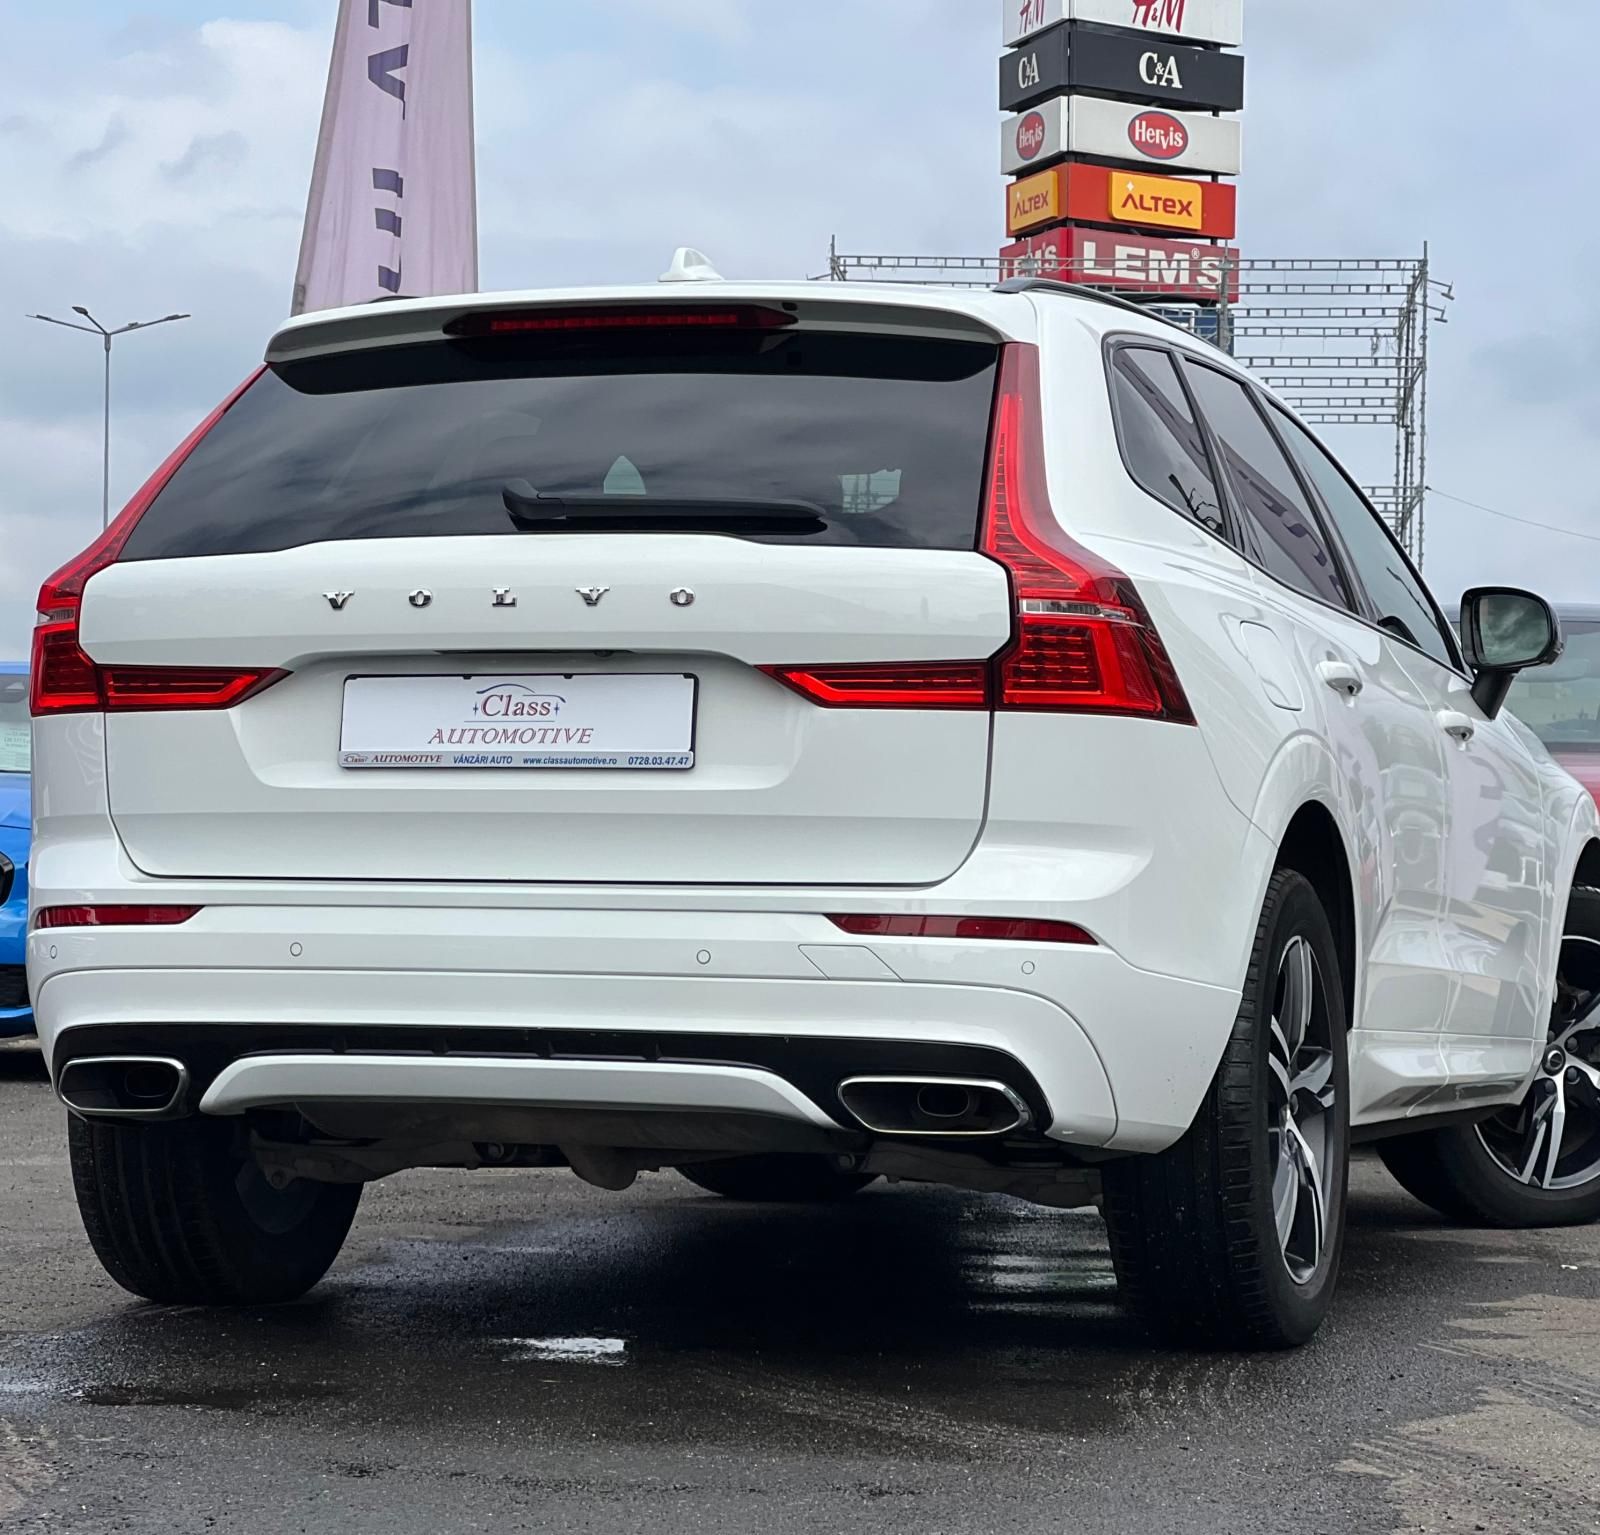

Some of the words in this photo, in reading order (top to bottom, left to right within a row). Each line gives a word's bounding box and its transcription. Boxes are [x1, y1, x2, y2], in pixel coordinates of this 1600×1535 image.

[1018, 52, 1040, 89] C&A
[1138, 51, 1183, 89] C&A
[1018, 123, 1043, 149] Hervis
[1134, 119, 1184, 149] Hervis
[322, 586, 695, 611] VOLVO
[481, 693, 552, 717] Class
[427, 727, 595, 745] AUTOMOTIVE
[371, 754, 443, 763] AUTOMOTIVE
[489, 755, 513, 765] AUTO
[522, 756, 618, 766] www.classautomotive.ro
[628, 756, 690, 766] 0728.03.47.47
